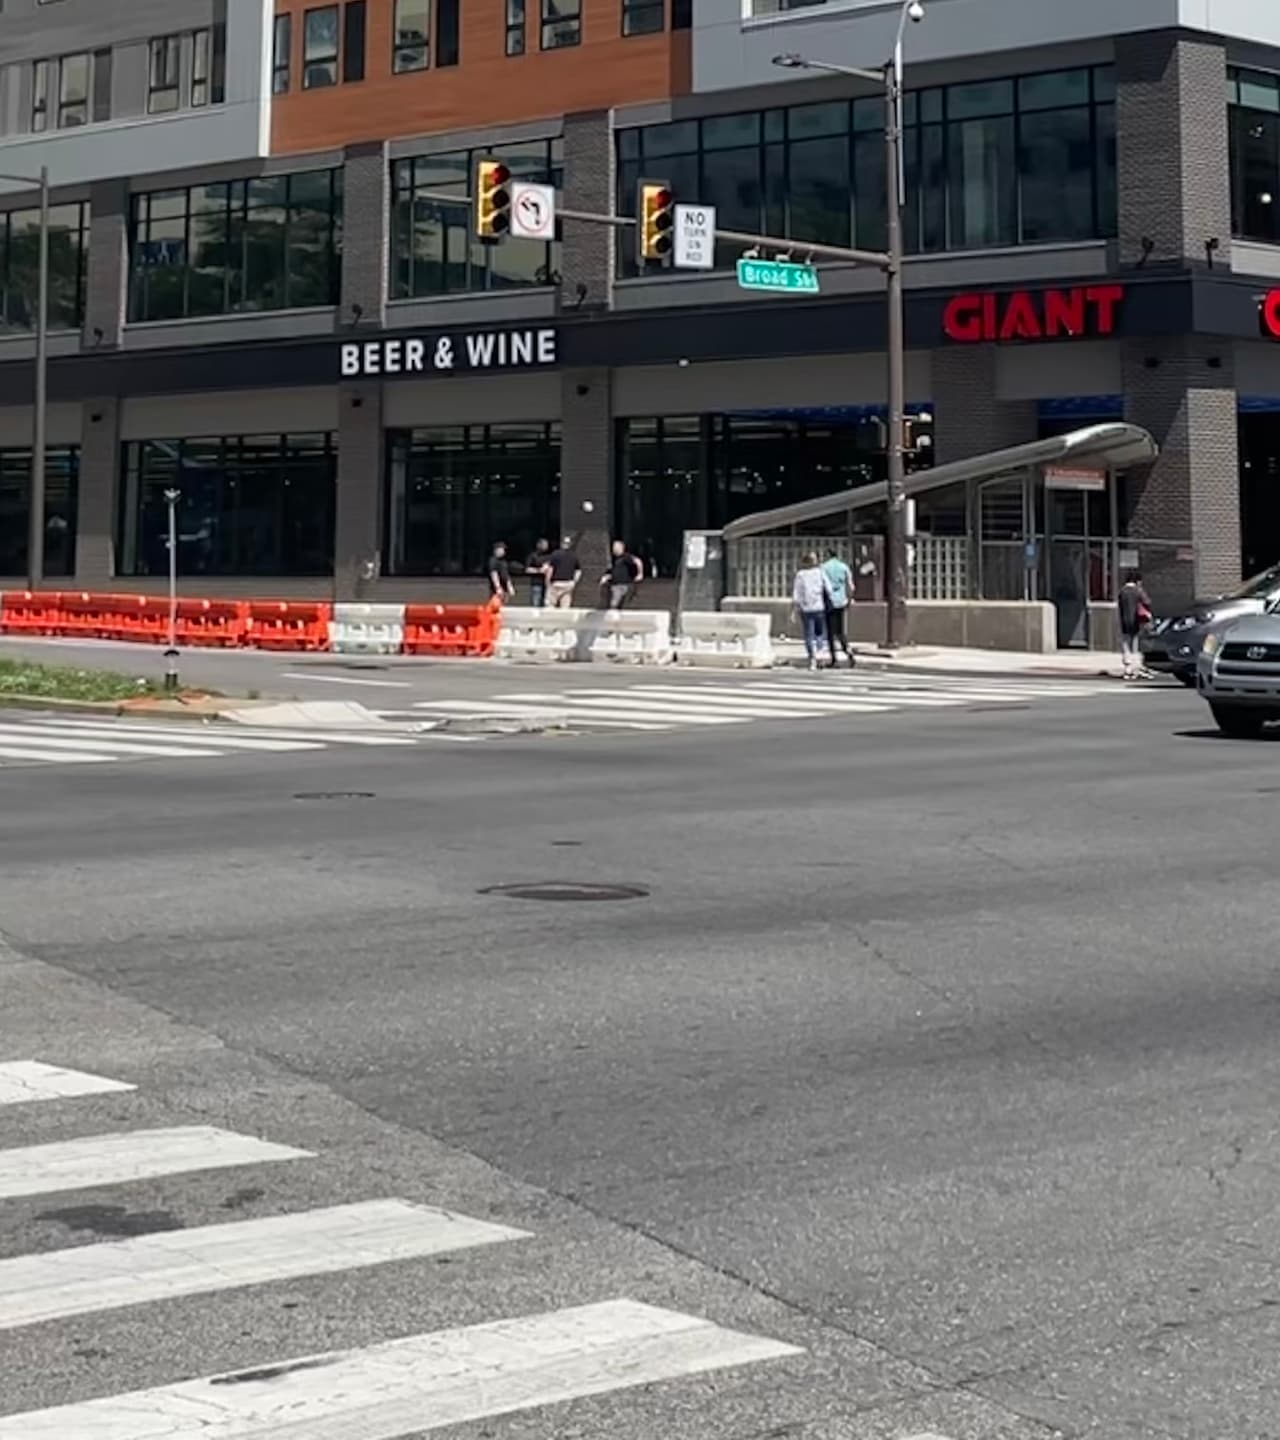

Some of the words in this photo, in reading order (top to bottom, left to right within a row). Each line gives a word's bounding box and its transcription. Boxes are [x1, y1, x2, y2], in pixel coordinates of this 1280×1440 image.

[684, 211, 706, 226] NO
[683, 227, 706, 238] TURN
[744, 266, 788, 285] Broad
[943, 286, 1124, 341] GIANT
[341, 339, 425, 375] BEER
[434, 337, 454, 369] &
[466, 329, 556, 367] WINE
